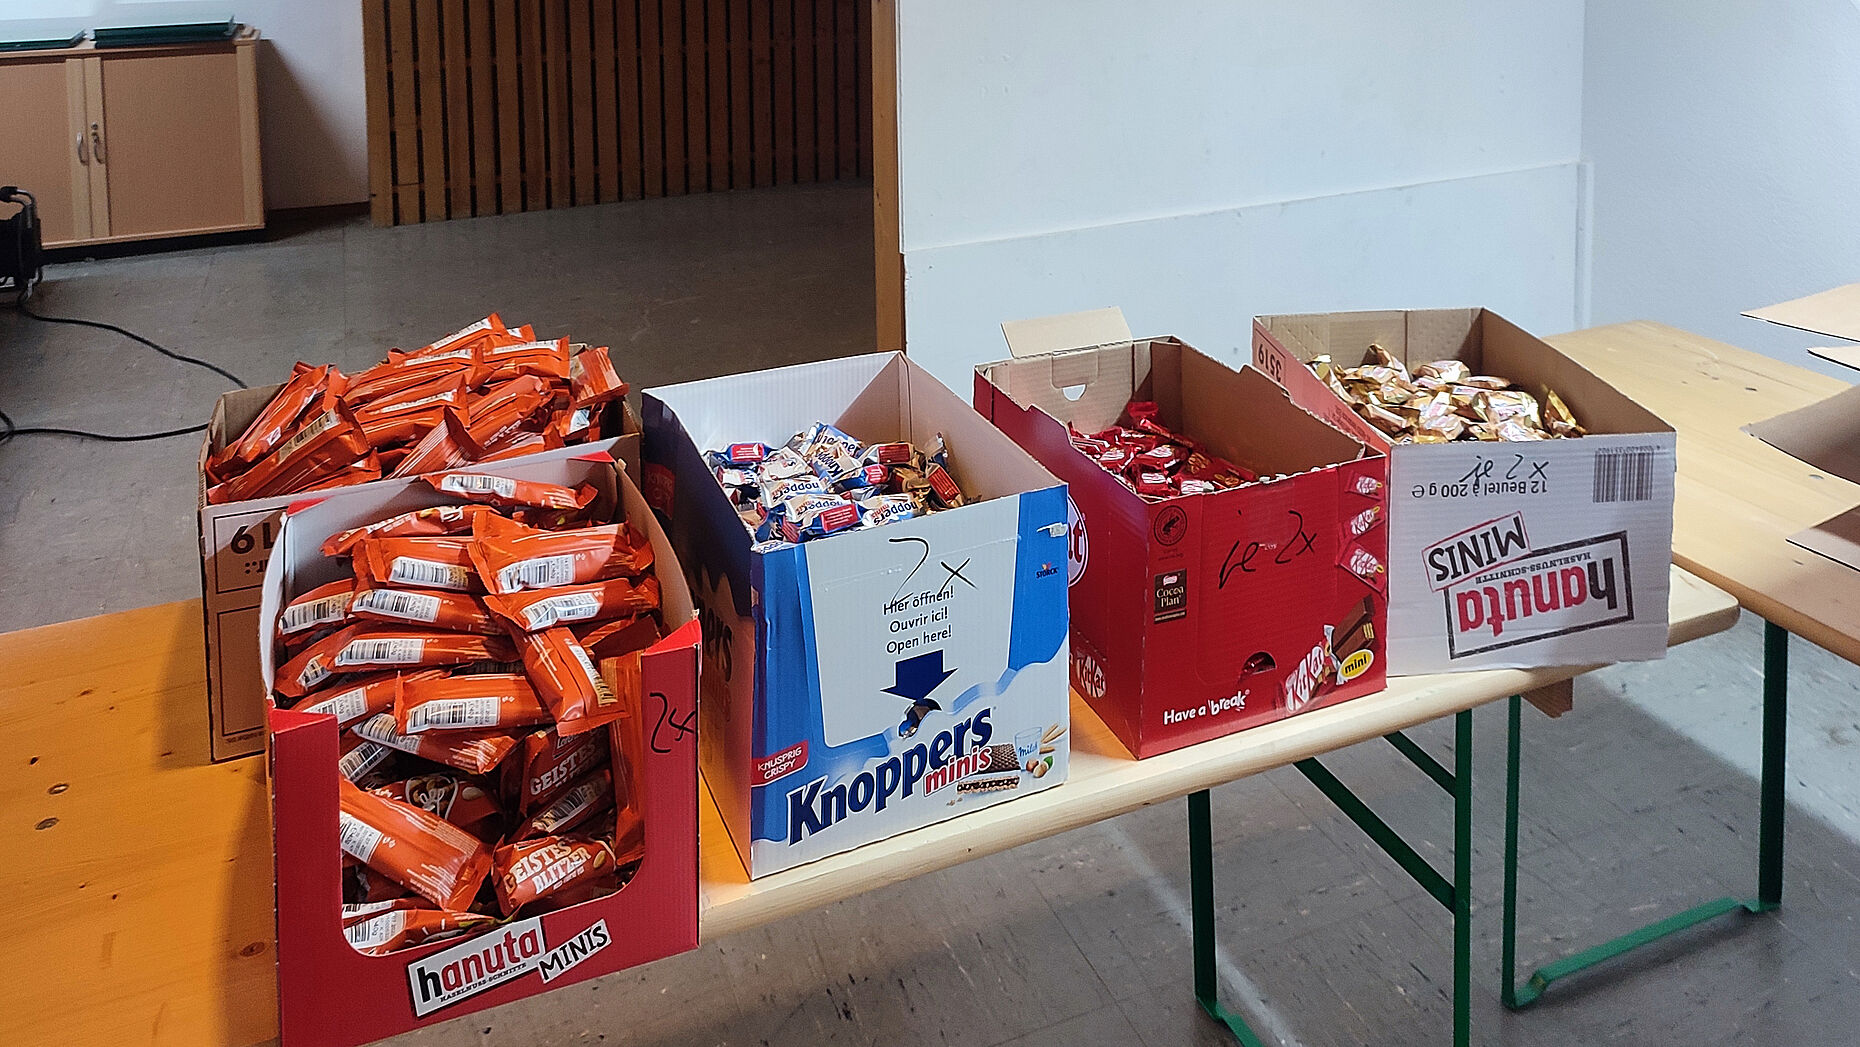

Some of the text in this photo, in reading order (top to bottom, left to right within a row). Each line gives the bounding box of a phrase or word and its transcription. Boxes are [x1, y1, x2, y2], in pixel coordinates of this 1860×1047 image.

[1430, 484, 1438, 497] g
[1441, 483, 1468, 497] 200
[1484, 481, 1527, 495] Beutel
[1531, 480, 1547, 494] 12
[1428, 516, 1527, 582] MINIS
[1036, 567, 1059, 579] STORCK
[1475, 552, 1591, 585] HASELNUSS-SCHNITTE
[883, 585, 954, 616] Hier öffnen!
[1156, 586, 1184, 599] Cocoa
[1161, 597, 1179, 608] Plan
[1456, 558, 1617, 637] hanuta
[889, 606, 949, 633] Ouvrir ici!
[886, 625, 953, 655] Open here!
[1344, 654, 1367, 674] mini
[1163, 709, 1196, 725] Have
[1198, 706, 1207, 716] a
[530, 742, 596, 796] GEISTES
[757, 746, 803, 773] KNUSPRIG
[763, 759, 797, 780] CRISPY
[924, 746, 993, 797] minis
[788, 707, 993, 847] Knoppers
[503, 841, 572, 895] GEISTES
[532, 847, 592, 895] BLITZER
[416, 929, 538, 1003] hanuta
[540, 925, 608, 981] MINIS
[440, 962, 527, 1002] HASELNUSS-SCHNITTE
